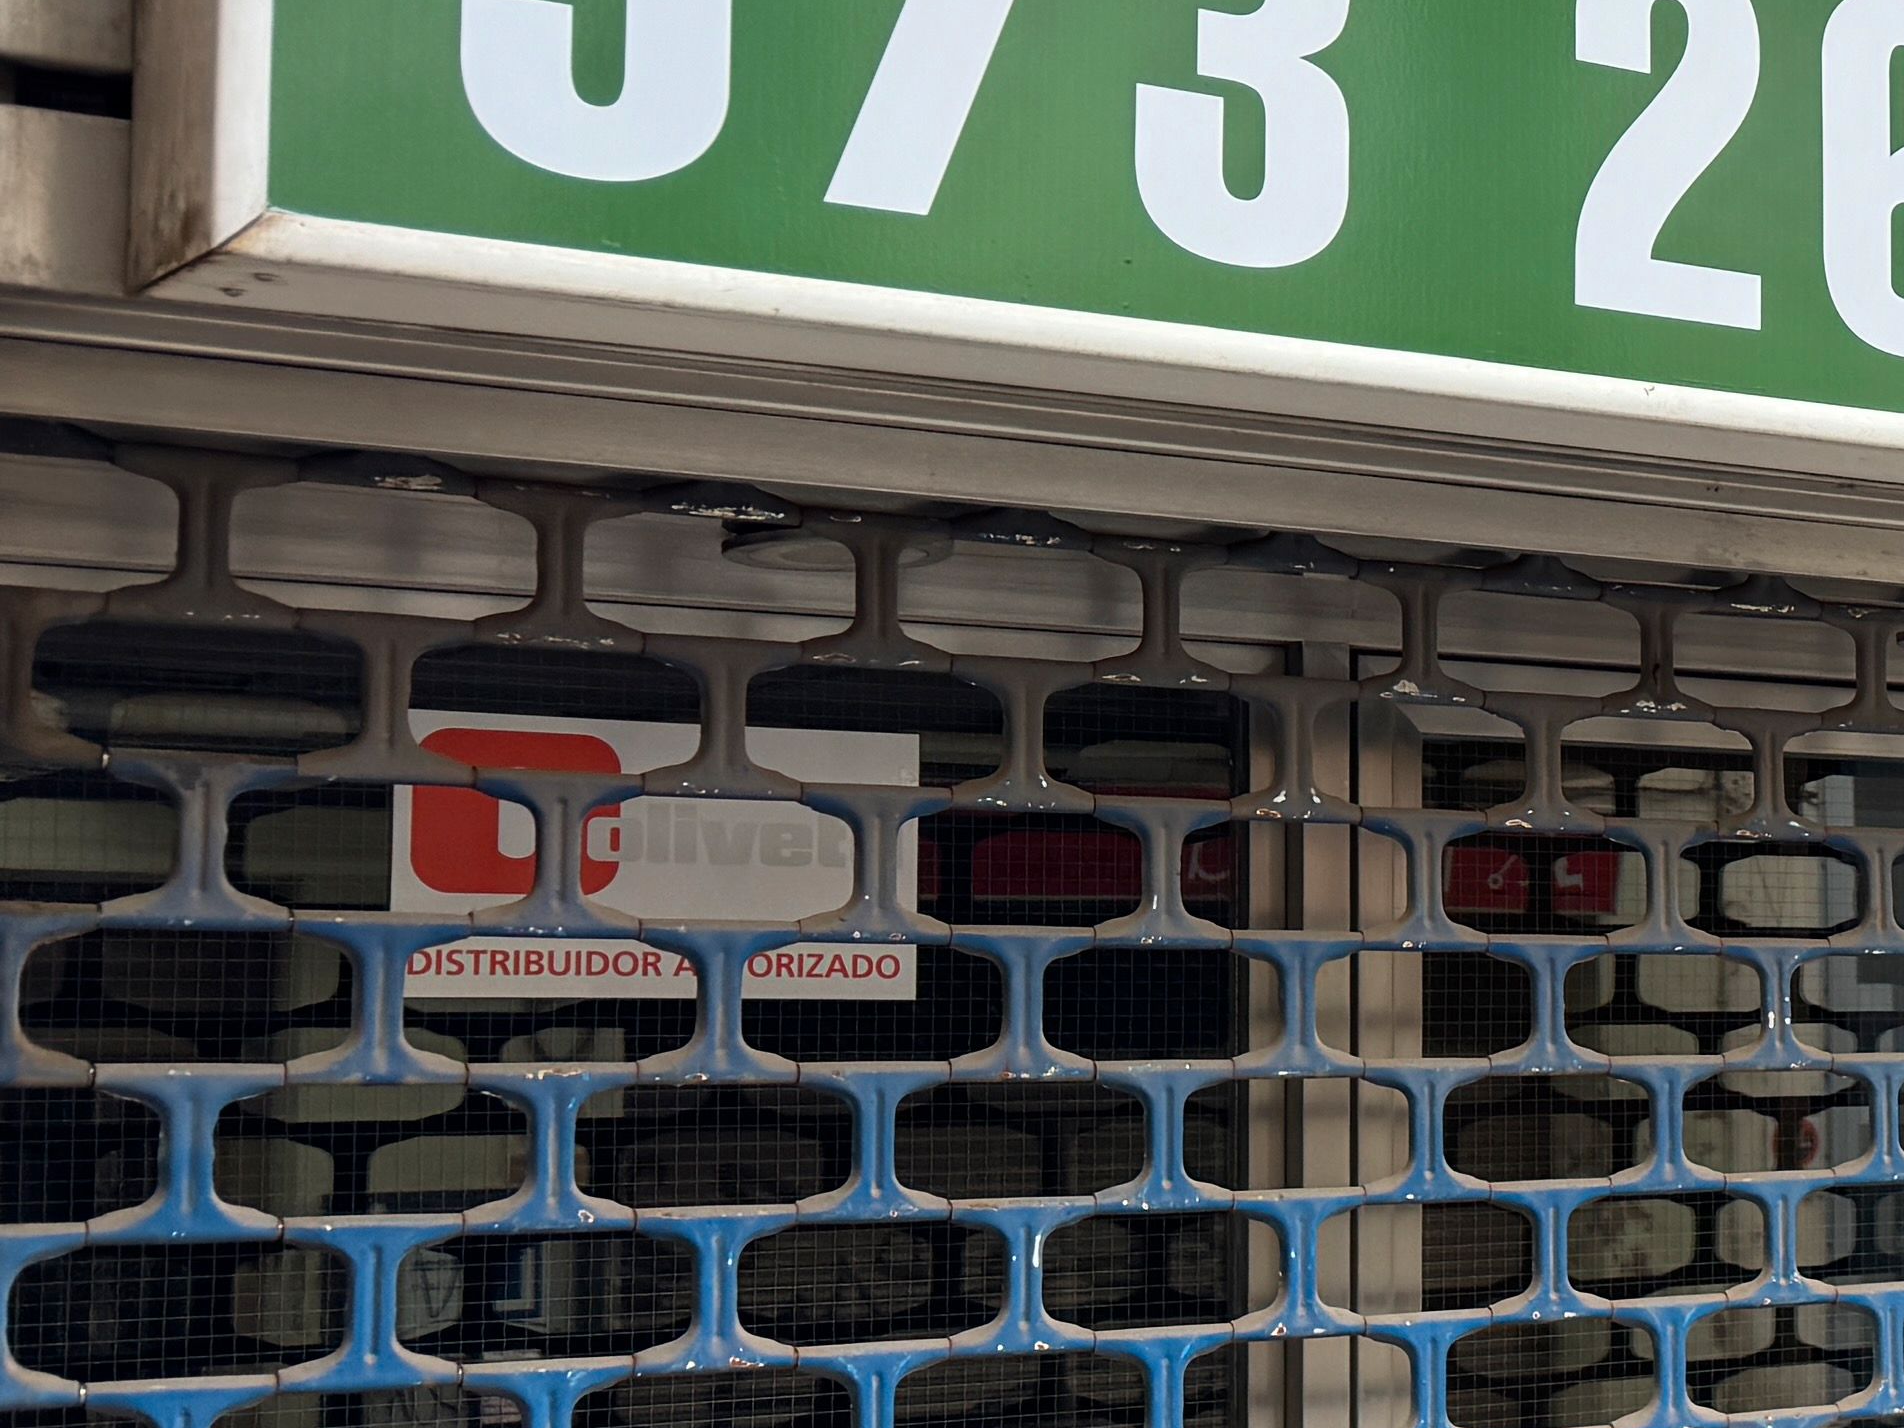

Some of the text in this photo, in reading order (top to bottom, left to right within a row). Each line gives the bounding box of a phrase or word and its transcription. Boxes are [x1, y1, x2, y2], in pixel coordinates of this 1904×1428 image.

[587, 802, 852, 869] olivet
[406, 948, 901, 980] DISTRIBUIDOR AORIZADO
